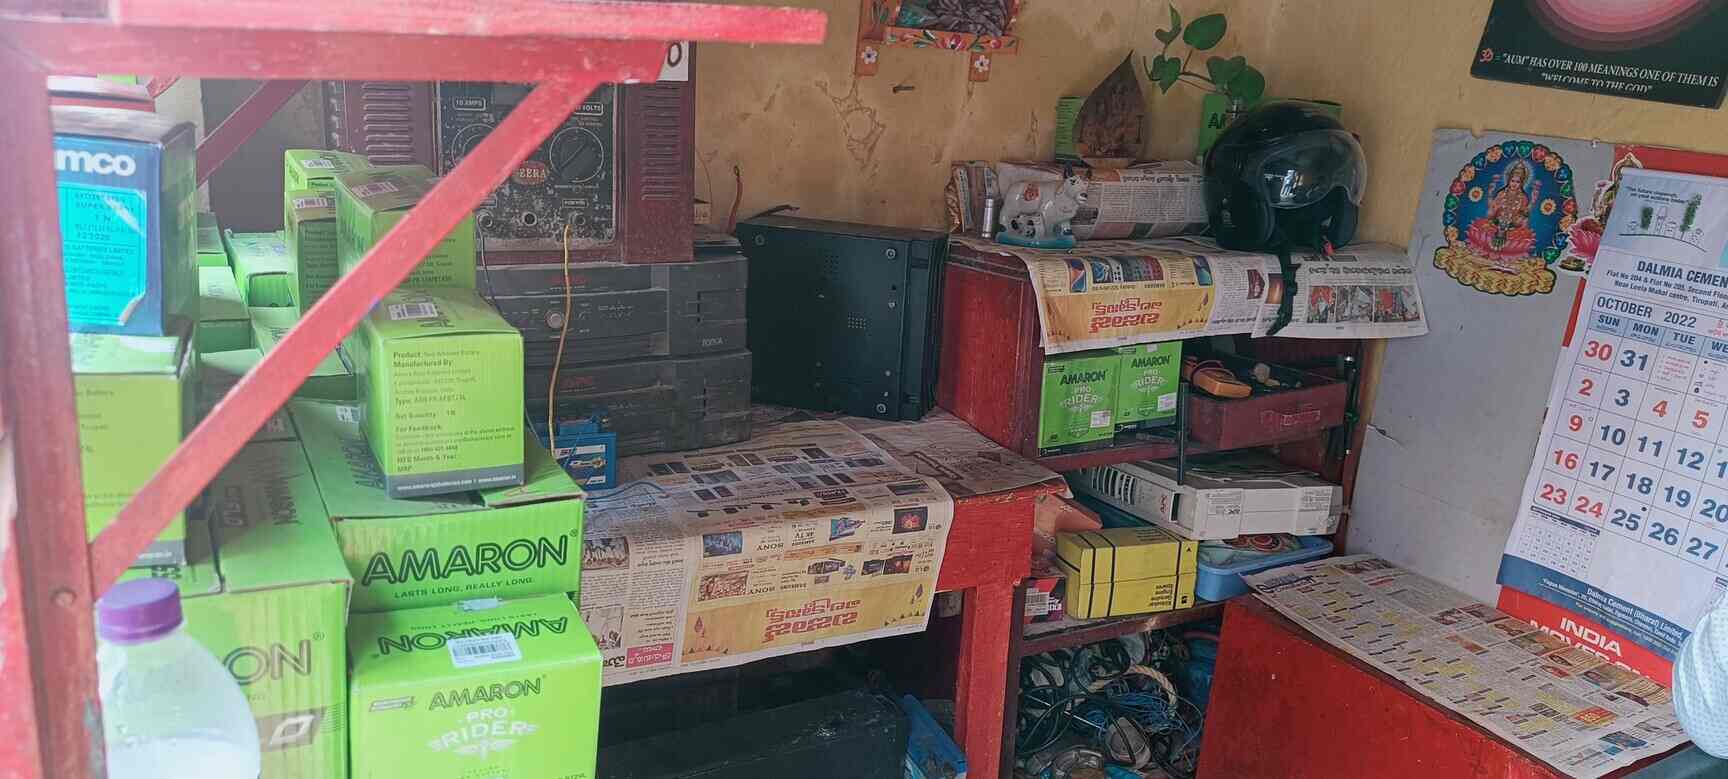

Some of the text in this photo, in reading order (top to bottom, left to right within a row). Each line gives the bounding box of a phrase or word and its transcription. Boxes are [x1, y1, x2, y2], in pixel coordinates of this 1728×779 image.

[1530, 56, 1547, 68] HAS
[1548, 58, 1573, 71] OVER
[1574, 61, 1588, 73] 100
[1587, 63, 1639, 79] MEANINGS
[1639, 68, 1661, 81] ONE
[1661, 70, 1677, 83] OF
[1678, 73, 1707, 87] THEM
[1706, 75, 1720, 88] IS
[55, 149, 136, 177] mco
[1637, 261, 1682, 279] DALMIA
[1597, 297, 1697, 329] OCTOBER 2022
[1598, 314, 1620, 327] SUN
[1632, 323, 1659, 336] MON
[1673, 332, 1696, 345] TUE
[1131, 355, 1172, 369] AMARON
[1584, 340, 1613, 361] 30
[1620, 350, 1648, 371] 31
[1060, 369, 1106, 386] AMARON
[1578, 379, 1710, 429] 2 3 4 5
[1569, 415, 1583, 432] 9
[1601, 425, 1626, 446] 10
[1638, 436, 1663, 457] 11
[1677, 448, 1705, 470] 12
[1554, 449, 1728, 523] 16 17 18 19 20
[1540, 483, 1719, 560] 23 24 25 26 27
[361, 534, 568, 587] AMARON
[756, 542, 784, 551] SONY
[395, 588, 428, 599] LASTS
[466, 580, 502, 592] REALLY
[750, 586, 775, 594] SONY
[1608, 598, 1633, 615] Cement
[1560, 617, 1623, 657] INDIA
[429, 678, 541, 711] AMARON
[466, 707, 508, 721] PRO
[440, 719, 528, 747] RIDER
